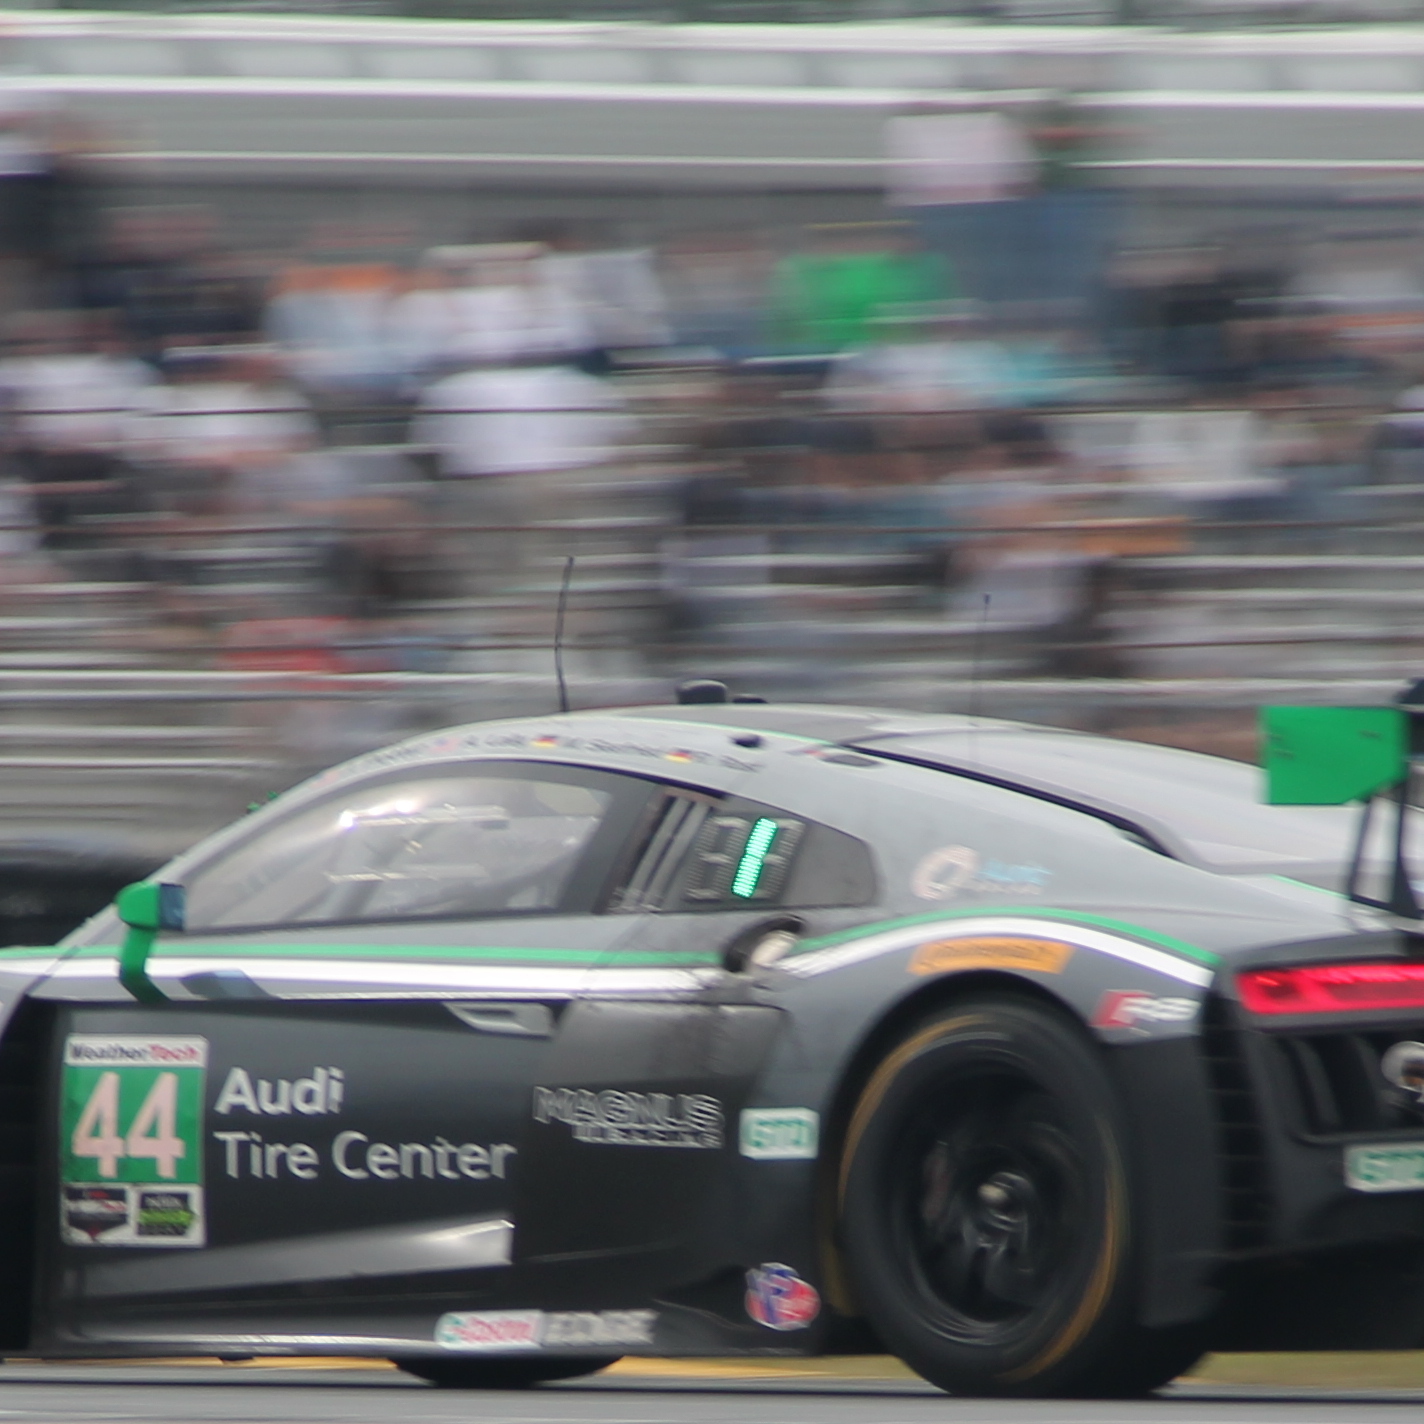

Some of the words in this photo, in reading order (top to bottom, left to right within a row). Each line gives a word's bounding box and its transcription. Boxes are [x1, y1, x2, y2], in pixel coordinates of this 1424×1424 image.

[213, 1065, 344, 1115] Audi
[71, 1071, 185, 1179] 44
[212, 1130, 320, 1180] Tire
[331, 1130, 519, 1180] Center
